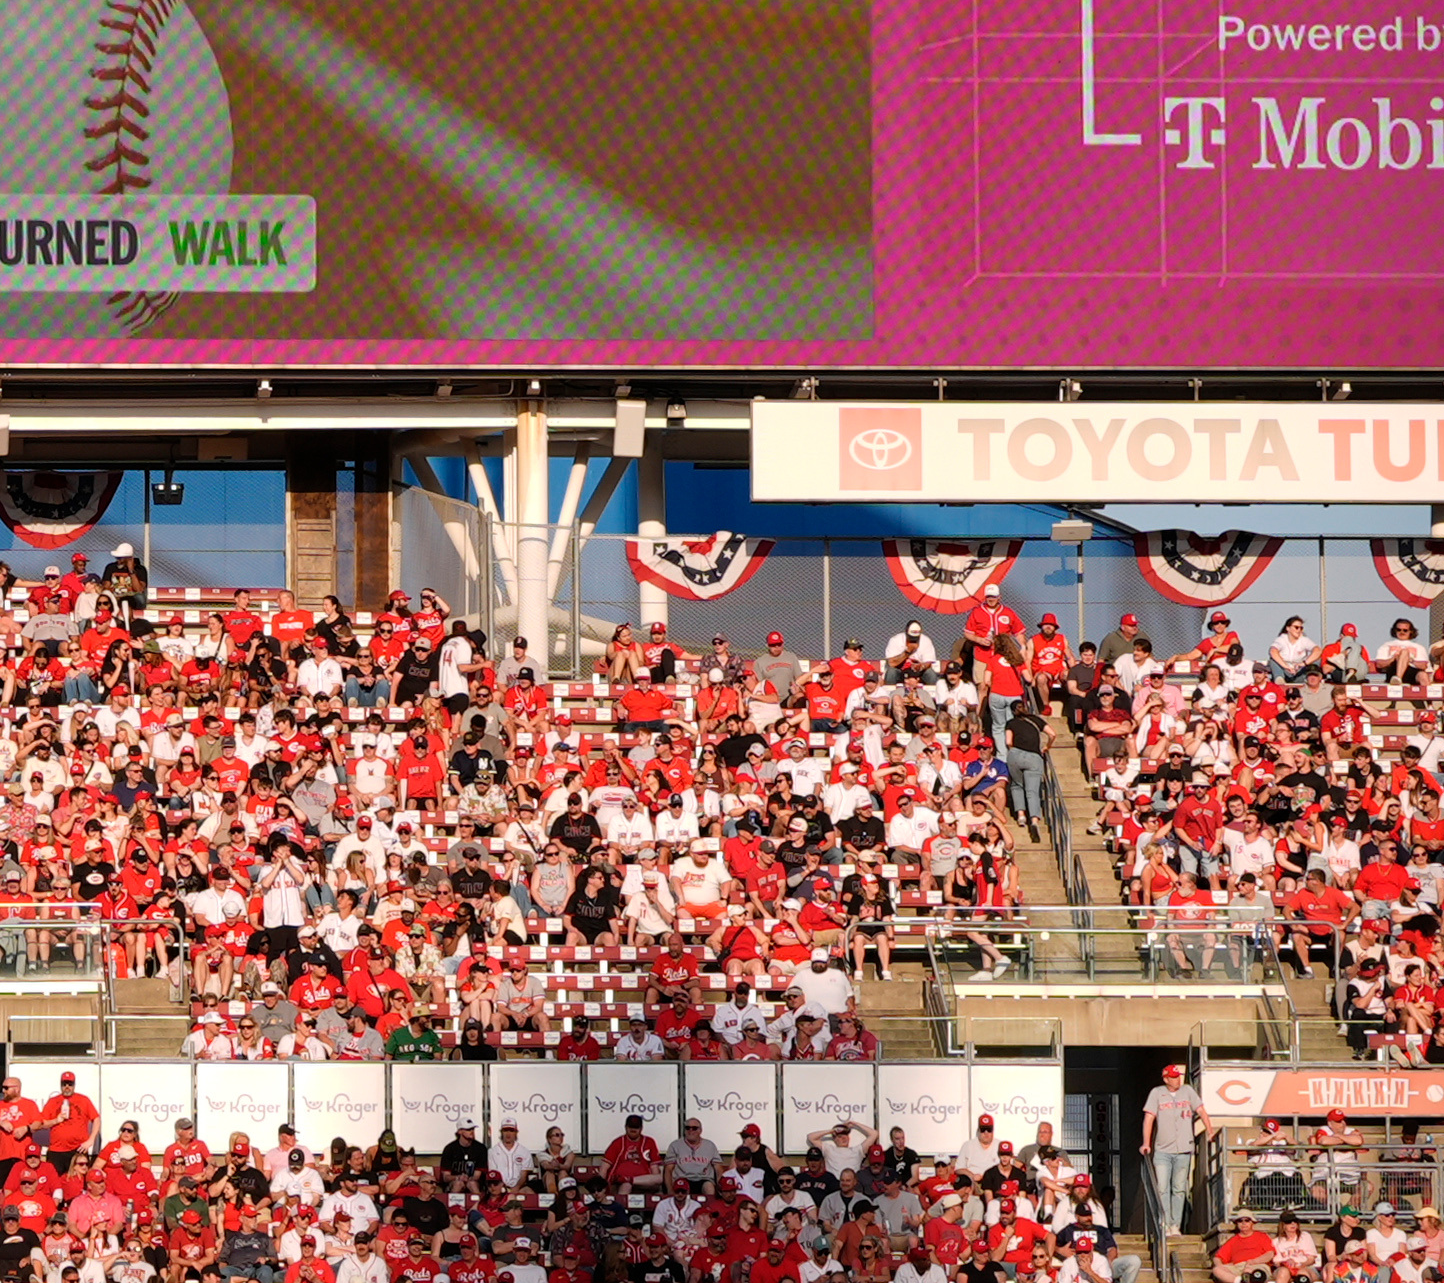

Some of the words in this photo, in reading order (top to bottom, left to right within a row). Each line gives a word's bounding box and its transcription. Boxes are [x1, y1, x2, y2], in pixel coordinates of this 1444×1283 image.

[1219, 16, 1404, 51] Powered
[169, 220, 287, 266] WALK
[957, 418, 1304, 482] TOYOTA
[663, 967, 688, 981] Reds
[718, 1092, 769, 1120] Kroger
[1216, 1079, 1255, 1105] C
[132, 1094, 184, 1122] Kroger
[230, 1094, 280, 1122] Kroger
[327, 1094, 378, 1121] Kroger
[425, 1094, 475, 1122] Kroger
[522, 1094, 573, 1122] Kroger
[620, 1094, 671, 1122] Kroger
[815, 1094, 867, 1122] Kroger
[911, 1094, 962, 1122] Kroger
[1003, 1096, 1055, 1124] Kroger
